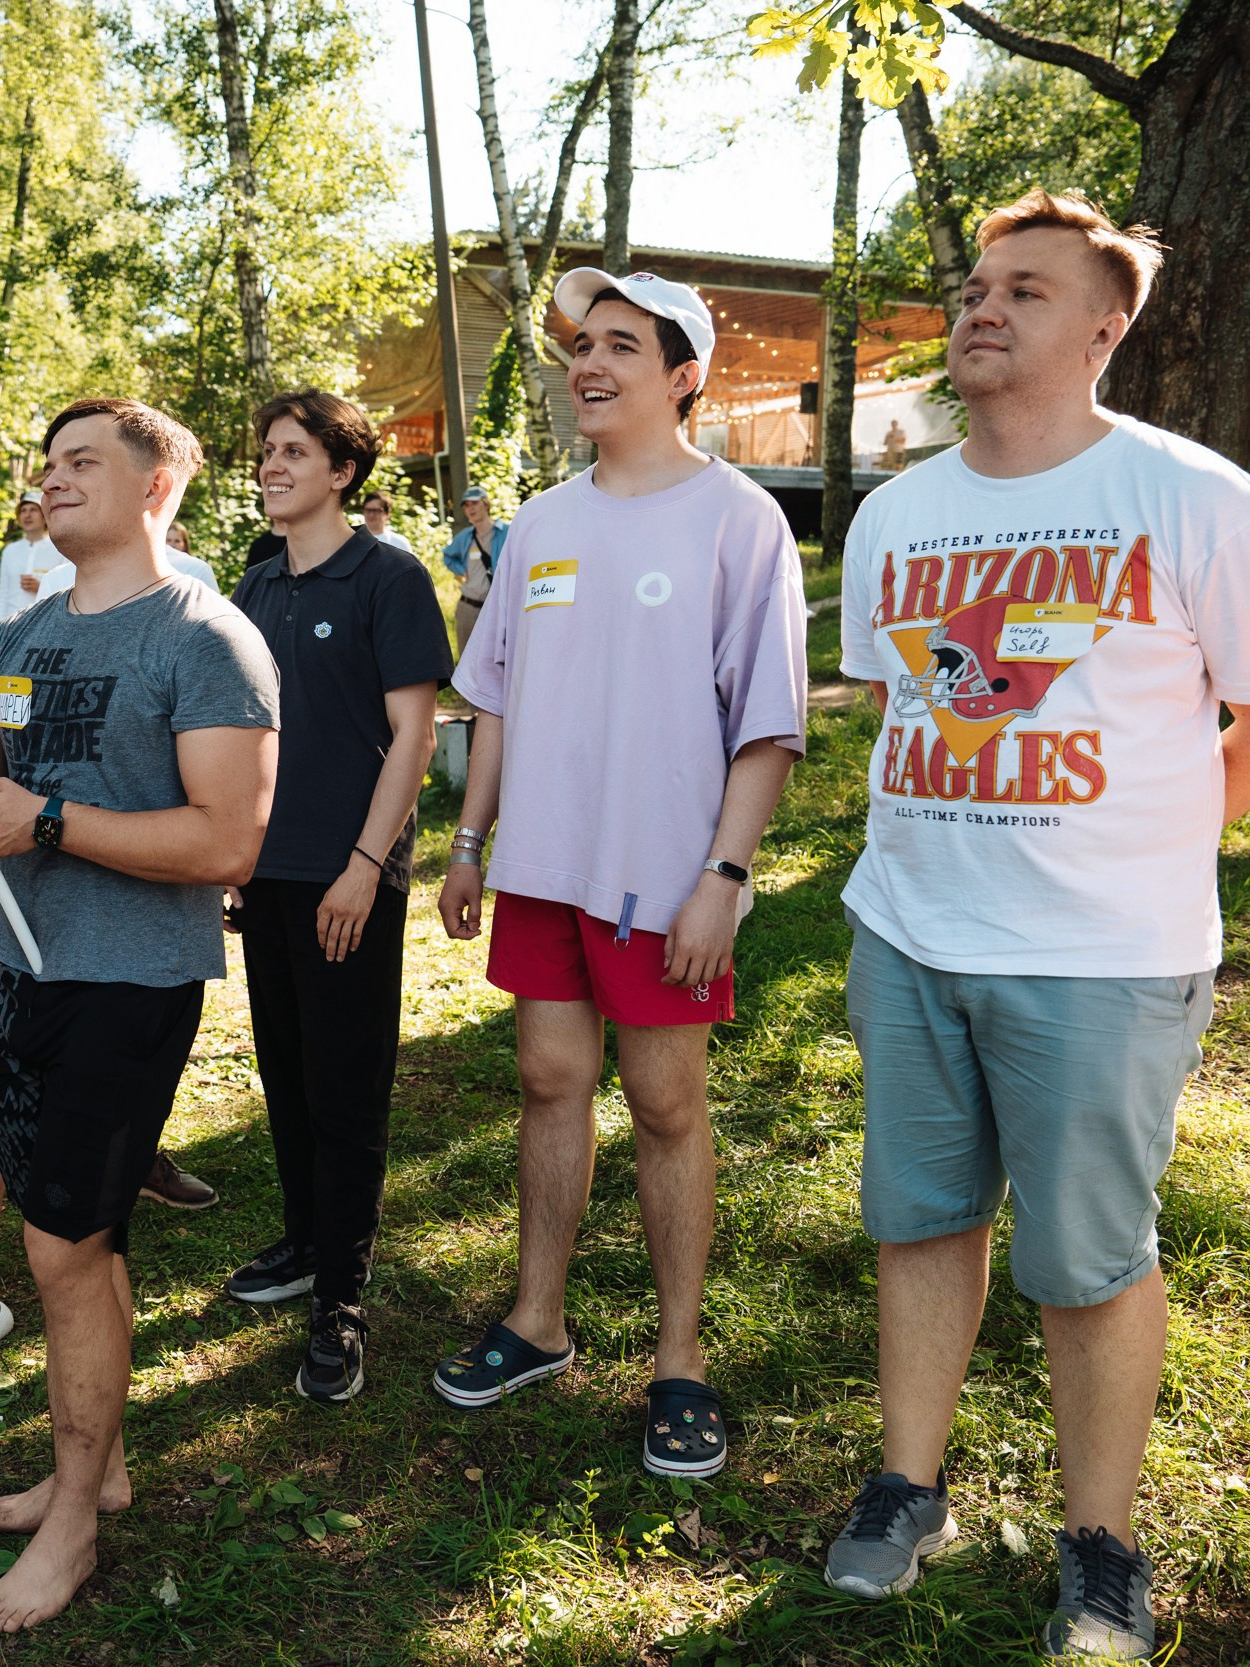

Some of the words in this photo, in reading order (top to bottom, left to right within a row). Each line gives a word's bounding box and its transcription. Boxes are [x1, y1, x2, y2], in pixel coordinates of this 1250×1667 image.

[908, 534, 984, 552] WESTERN
[995, 528, 1121, 544] CONFERENCE
[872, 535, 1157, 630] ARIZONA
[1006, 636, 1051, 655] Self
[20, 648, 73, 675] THE
[13, 721, 106, 763] MADE
[882, 726, 1107, 805] EAGLES
[895, 807, 958, 822] ALL-TIME
[966, 813, 1061, 827] CHAMPIONS
